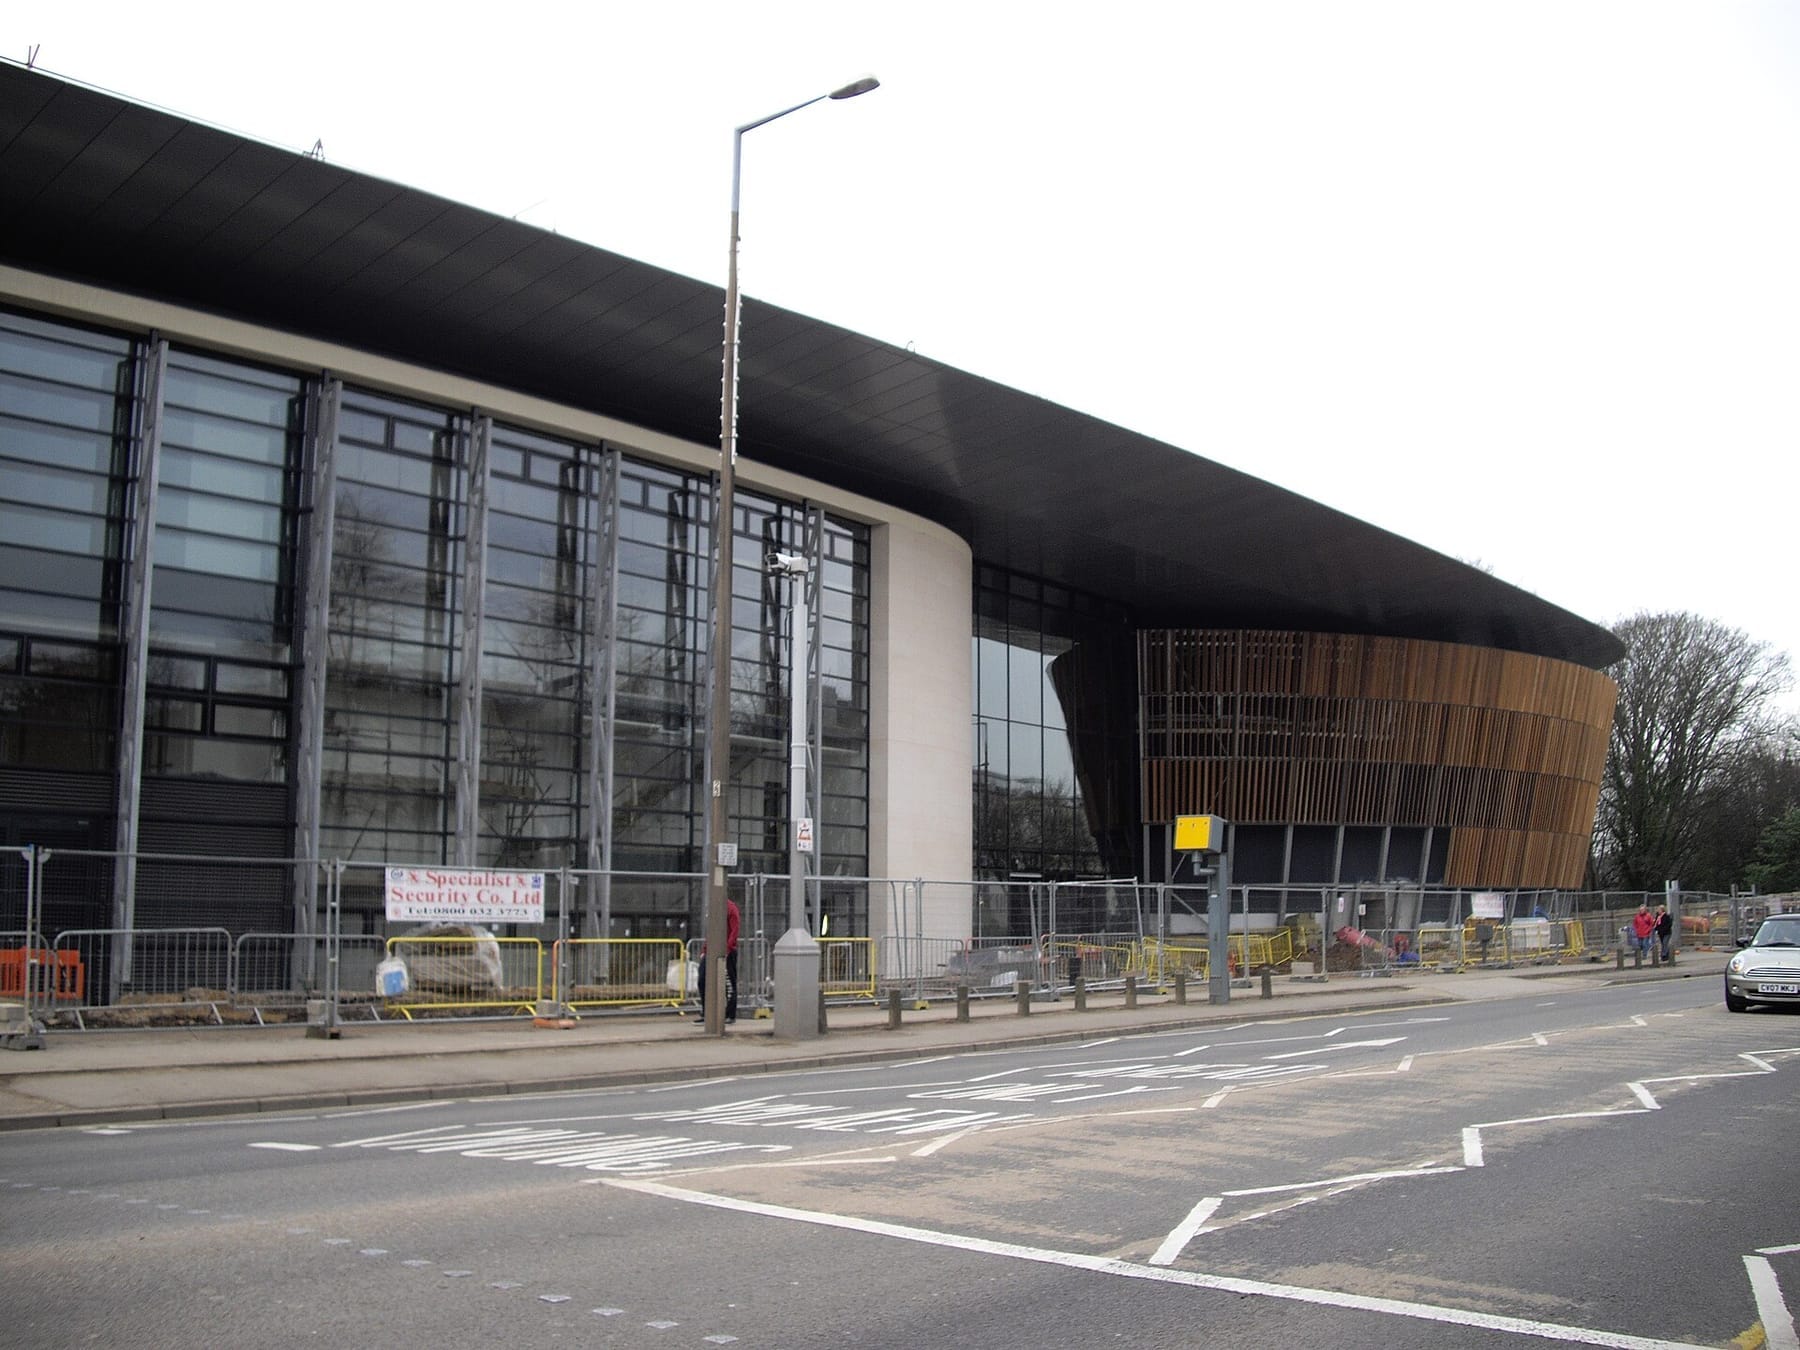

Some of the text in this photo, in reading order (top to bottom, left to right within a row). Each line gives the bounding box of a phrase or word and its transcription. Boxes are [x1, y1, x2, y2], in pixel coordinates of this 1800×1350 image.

[426, 871, 511, 888] Specialist
[391, 886, 541, 906] Security Co. Ltd
[1044, 1063, 1329, 1080] AHEAD
[907, 1082, 1182, 1103] ONLY
[632, 1102, 1033, 1135] YMLAEN
